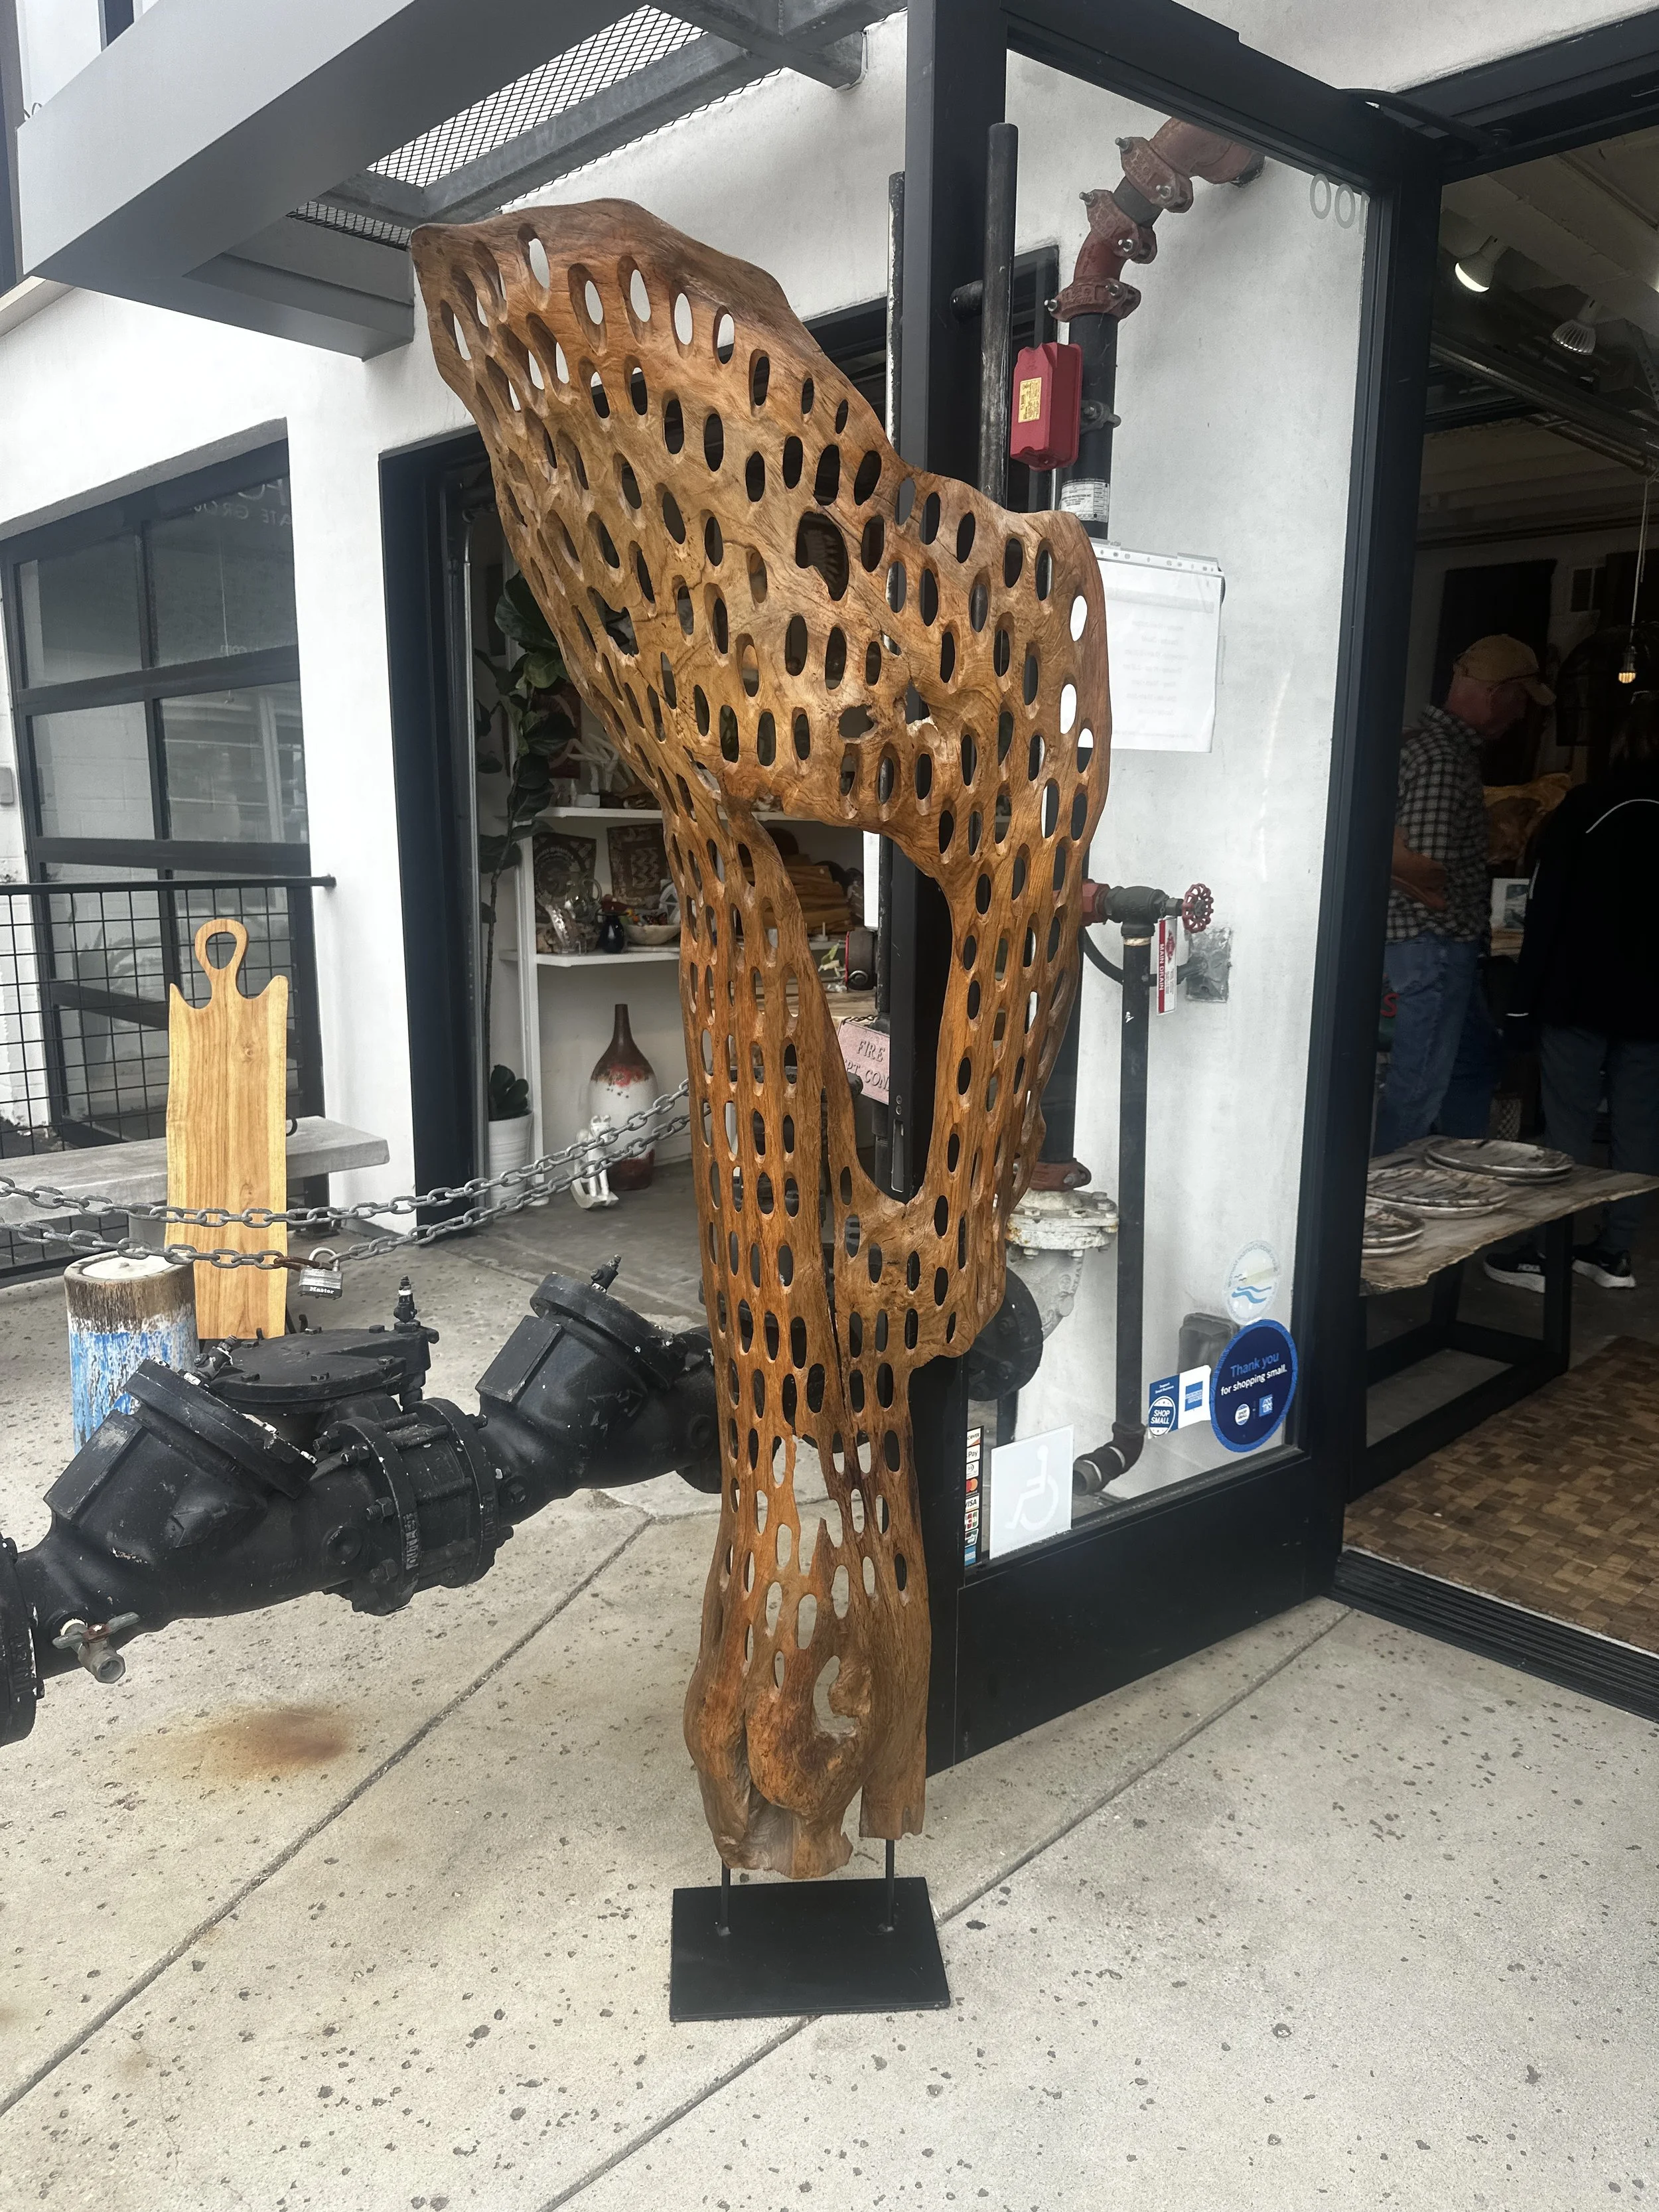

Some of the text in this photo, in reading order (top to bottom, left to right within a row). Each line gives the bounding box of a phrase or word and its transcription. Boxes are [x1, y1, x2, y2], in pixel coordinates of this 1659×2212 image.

[857, 1040, 886, 1063] FIRE
[845, 1059, 889, 1092] PT CON
[1220, 1363, 1287, 1396] for shopping small.
[1230, 1351, 1279, 1378] Thank you
